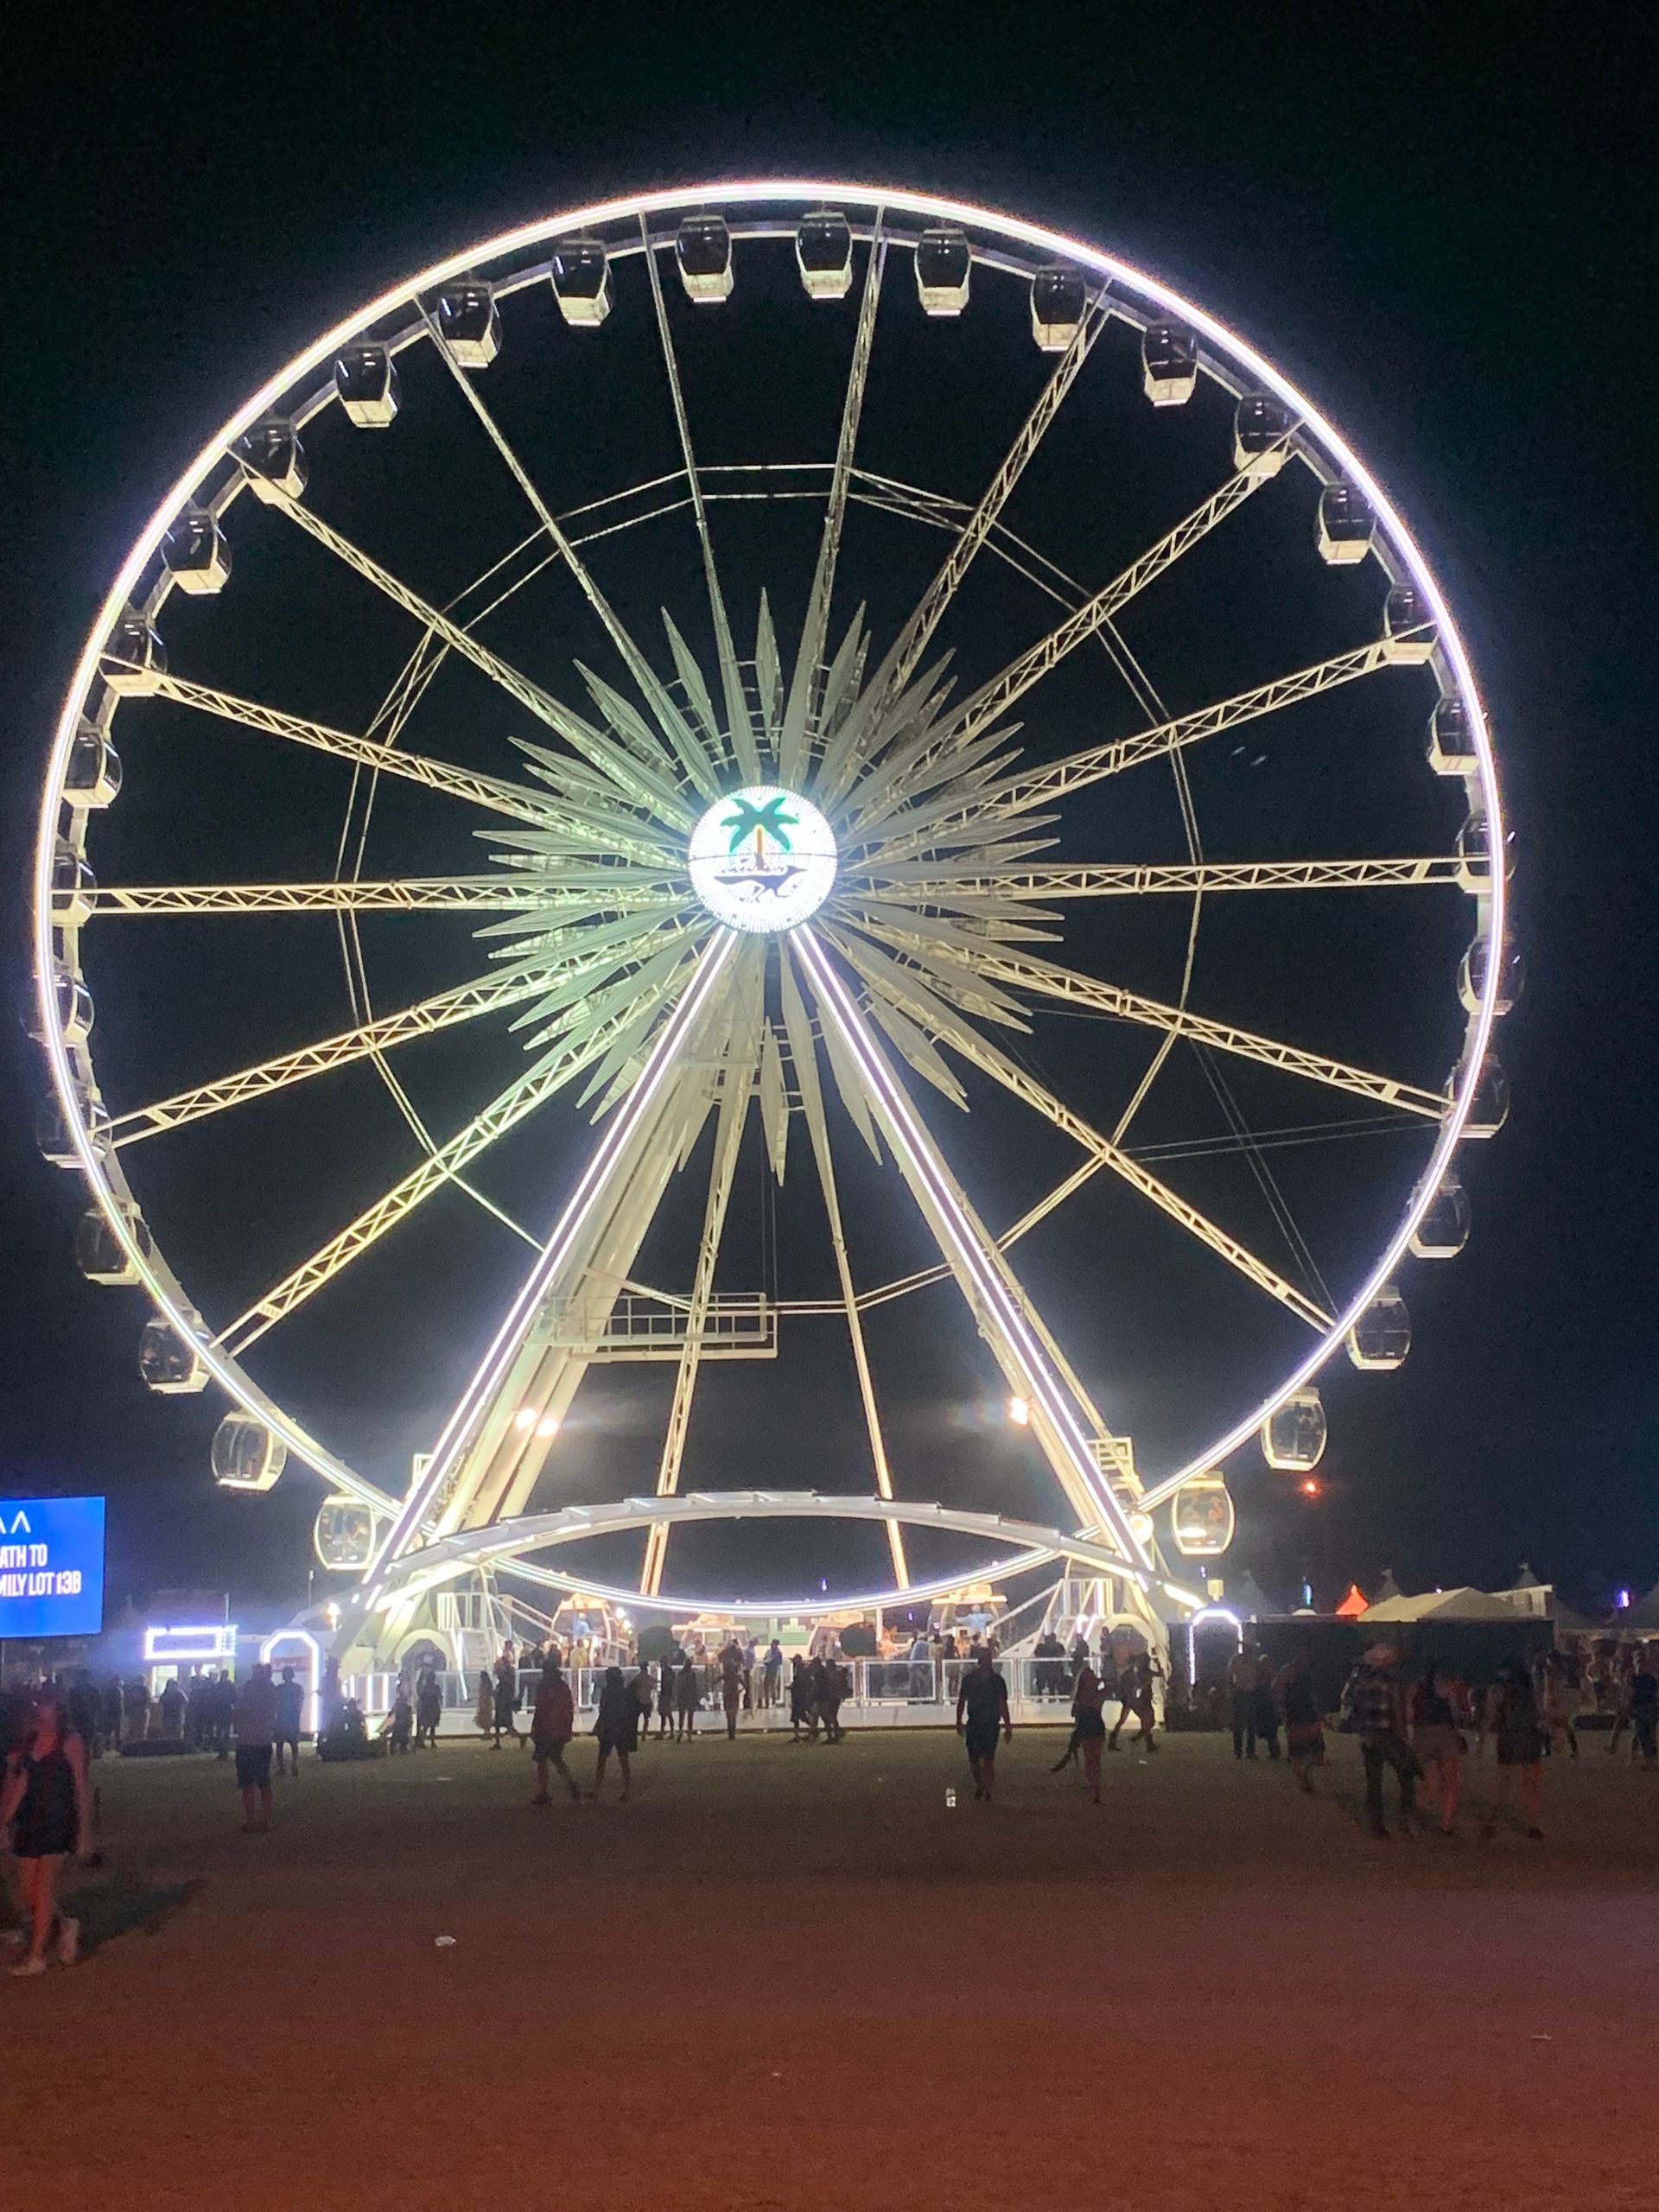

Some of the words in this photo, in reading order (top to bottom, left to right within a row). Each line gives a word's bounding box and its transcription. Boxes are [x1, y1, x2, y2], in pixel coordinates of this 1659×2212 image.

[29, 1543, 48, 1567] TO
[28, 1572, 55, 1596] LOT
[55, 1570, 81, 1594] 13B
